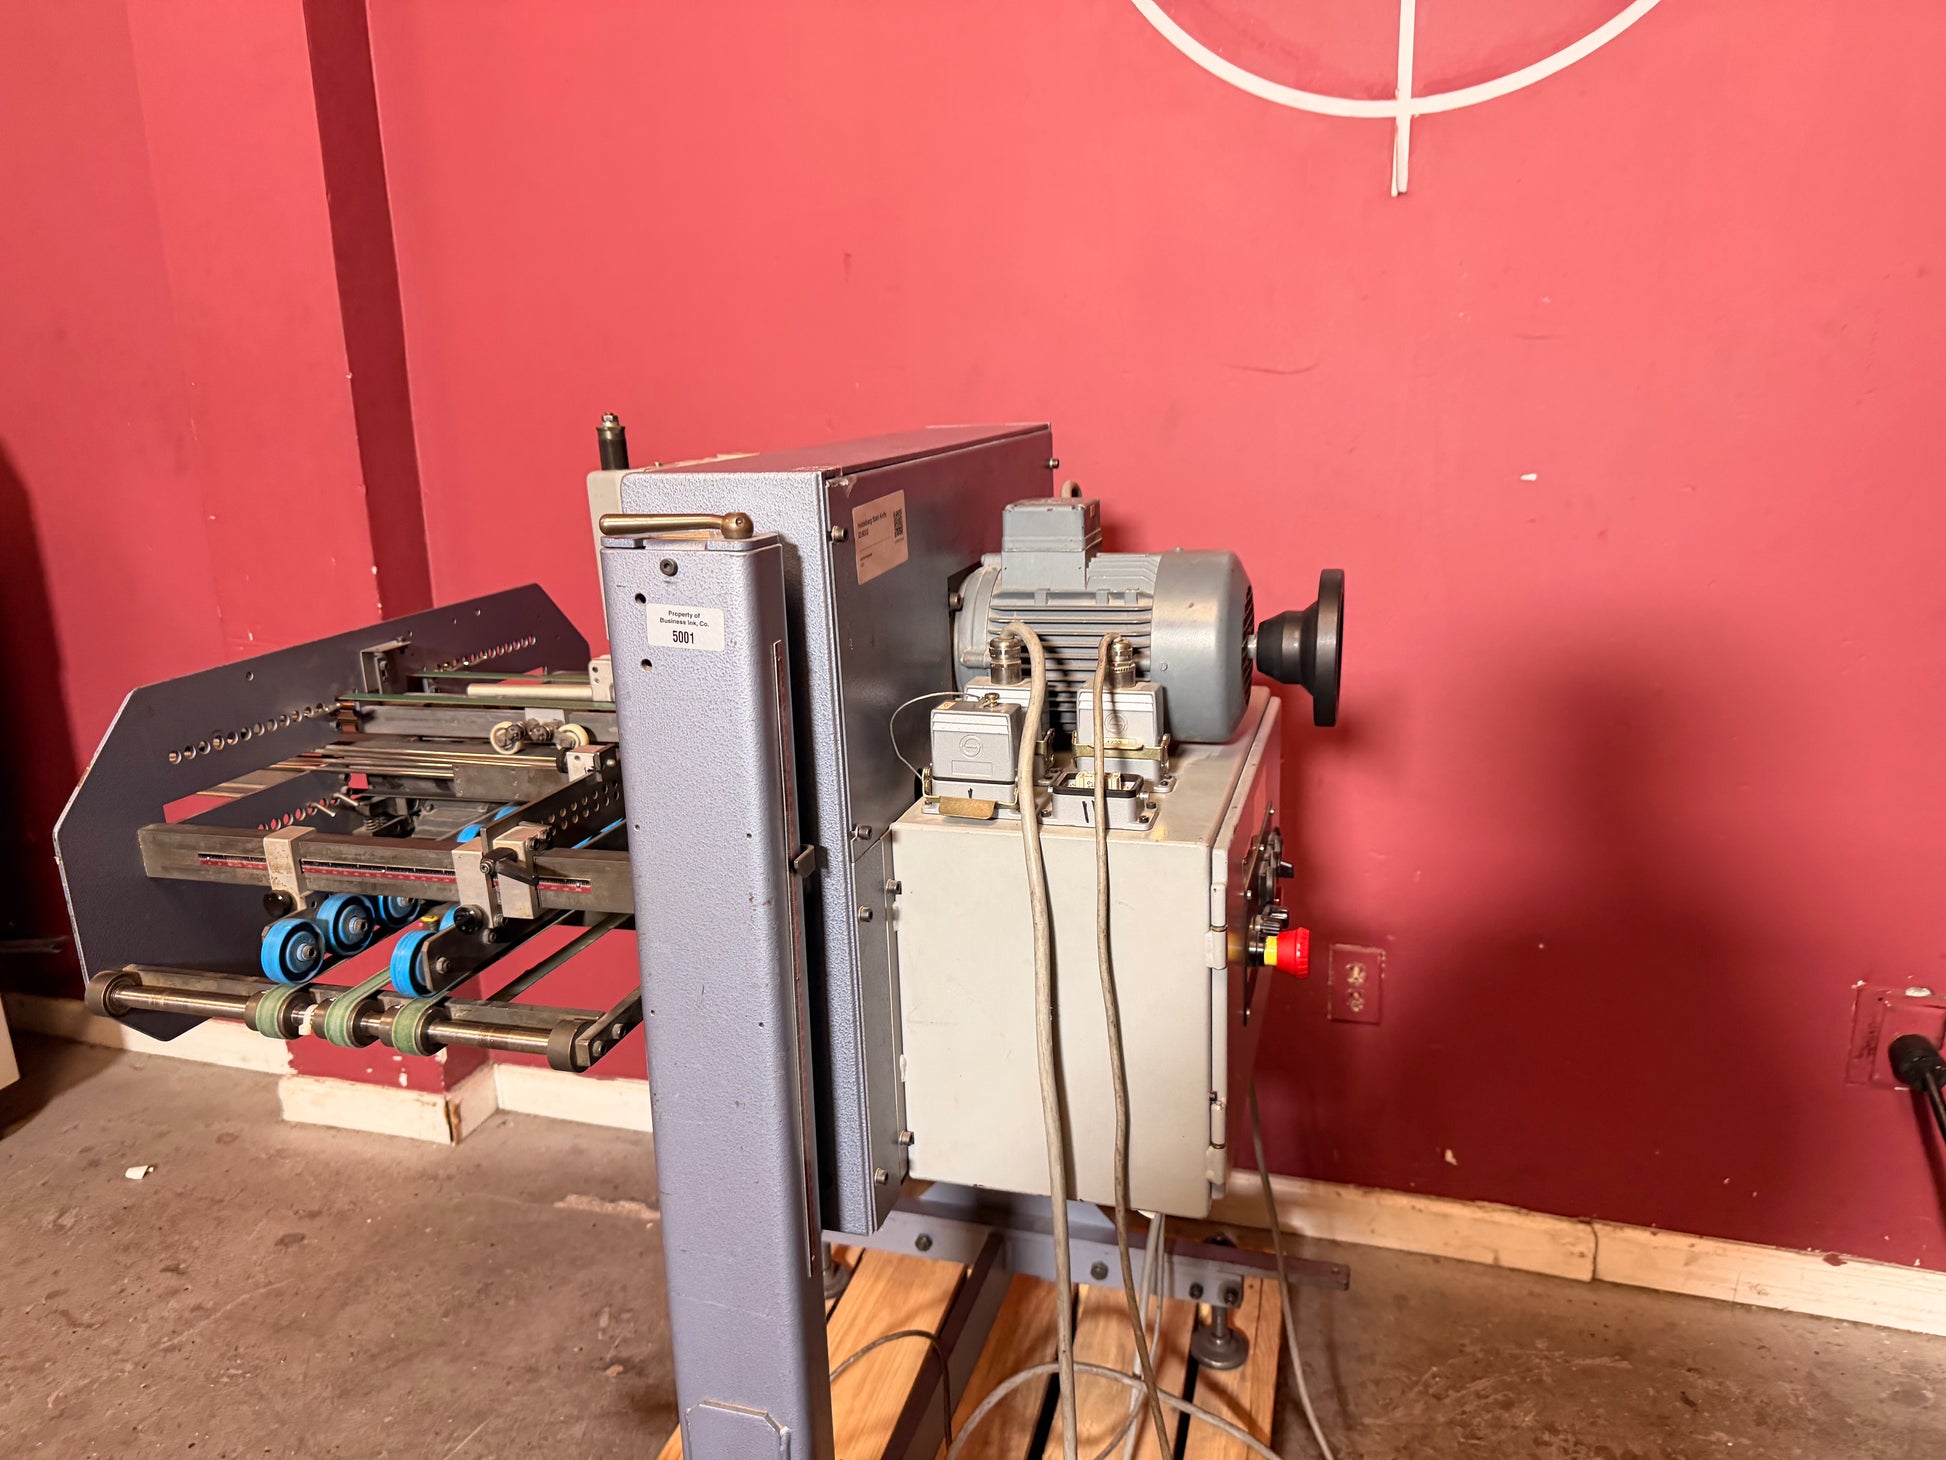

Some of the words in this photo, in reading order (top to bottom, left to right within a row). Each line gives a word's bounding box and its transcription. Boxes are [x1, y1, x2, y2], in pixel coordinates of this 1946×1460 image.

[668, 610, 693, 619] Property
[659, 617, 686, 625] Business
[672, 630, 694, 644] 5001
